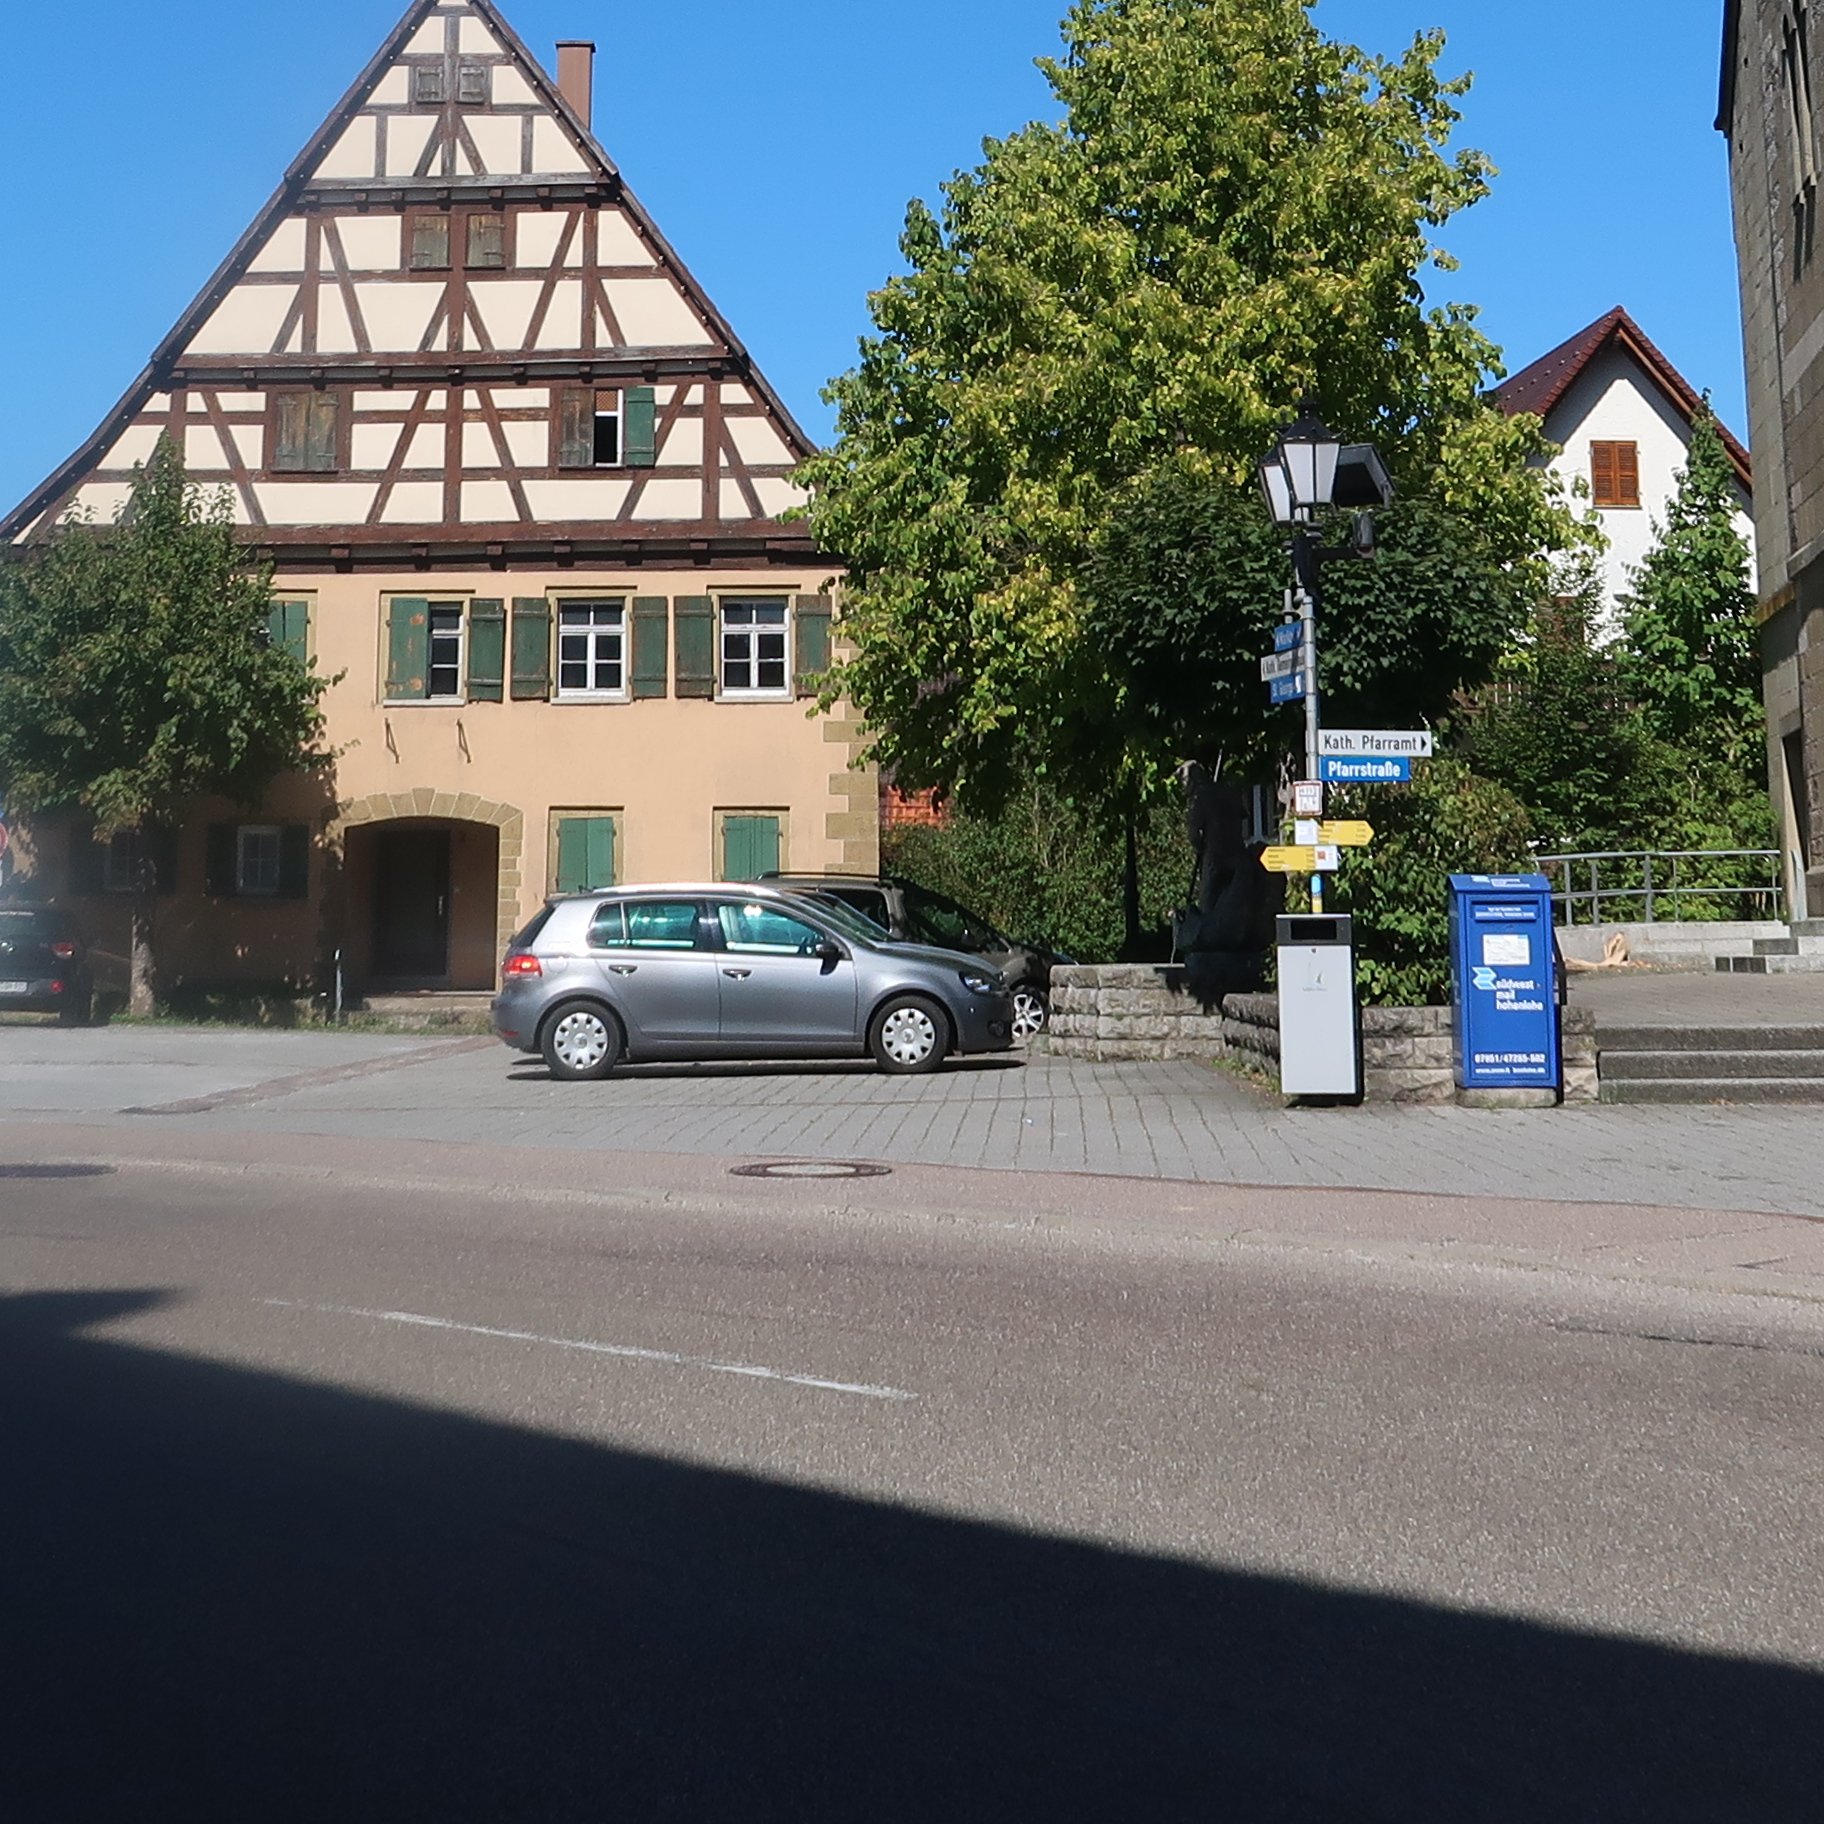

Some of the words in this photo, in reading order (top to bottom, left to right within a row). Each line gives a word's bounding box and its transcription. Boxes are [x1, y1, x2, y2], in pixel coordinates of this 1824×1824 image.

[1324, 735, 1356, 750] Kath.
[1362, 735, 1418, 751] Pfarramt
[1328, 761, 1401, 777] Pfarrstraße
